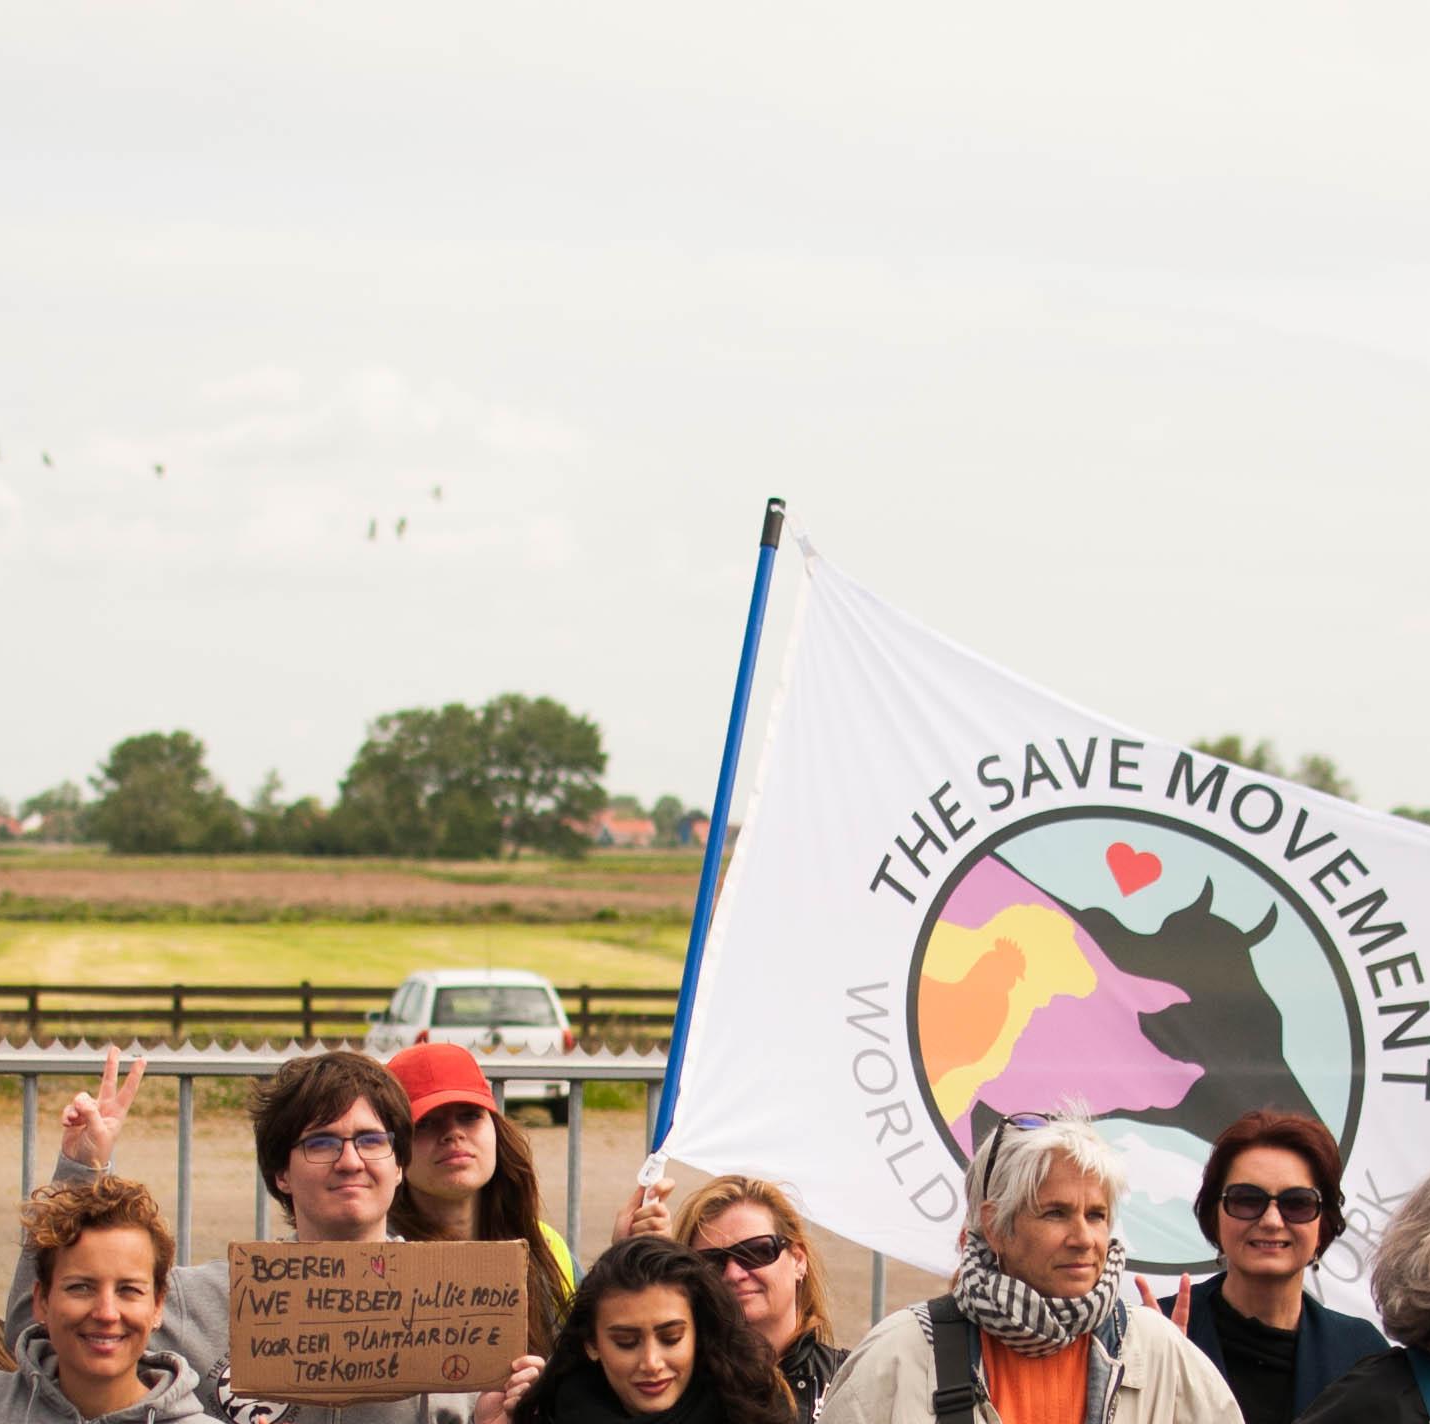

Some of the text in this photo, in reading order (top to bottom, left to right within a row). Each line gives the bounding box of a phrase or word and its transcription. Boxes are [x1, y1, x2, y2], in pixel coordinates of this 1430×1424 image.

[869, 780, 977, 905] THE
[976, 736, 1145, 812] SAVE
[249, 1290, 291, 1315] WE
